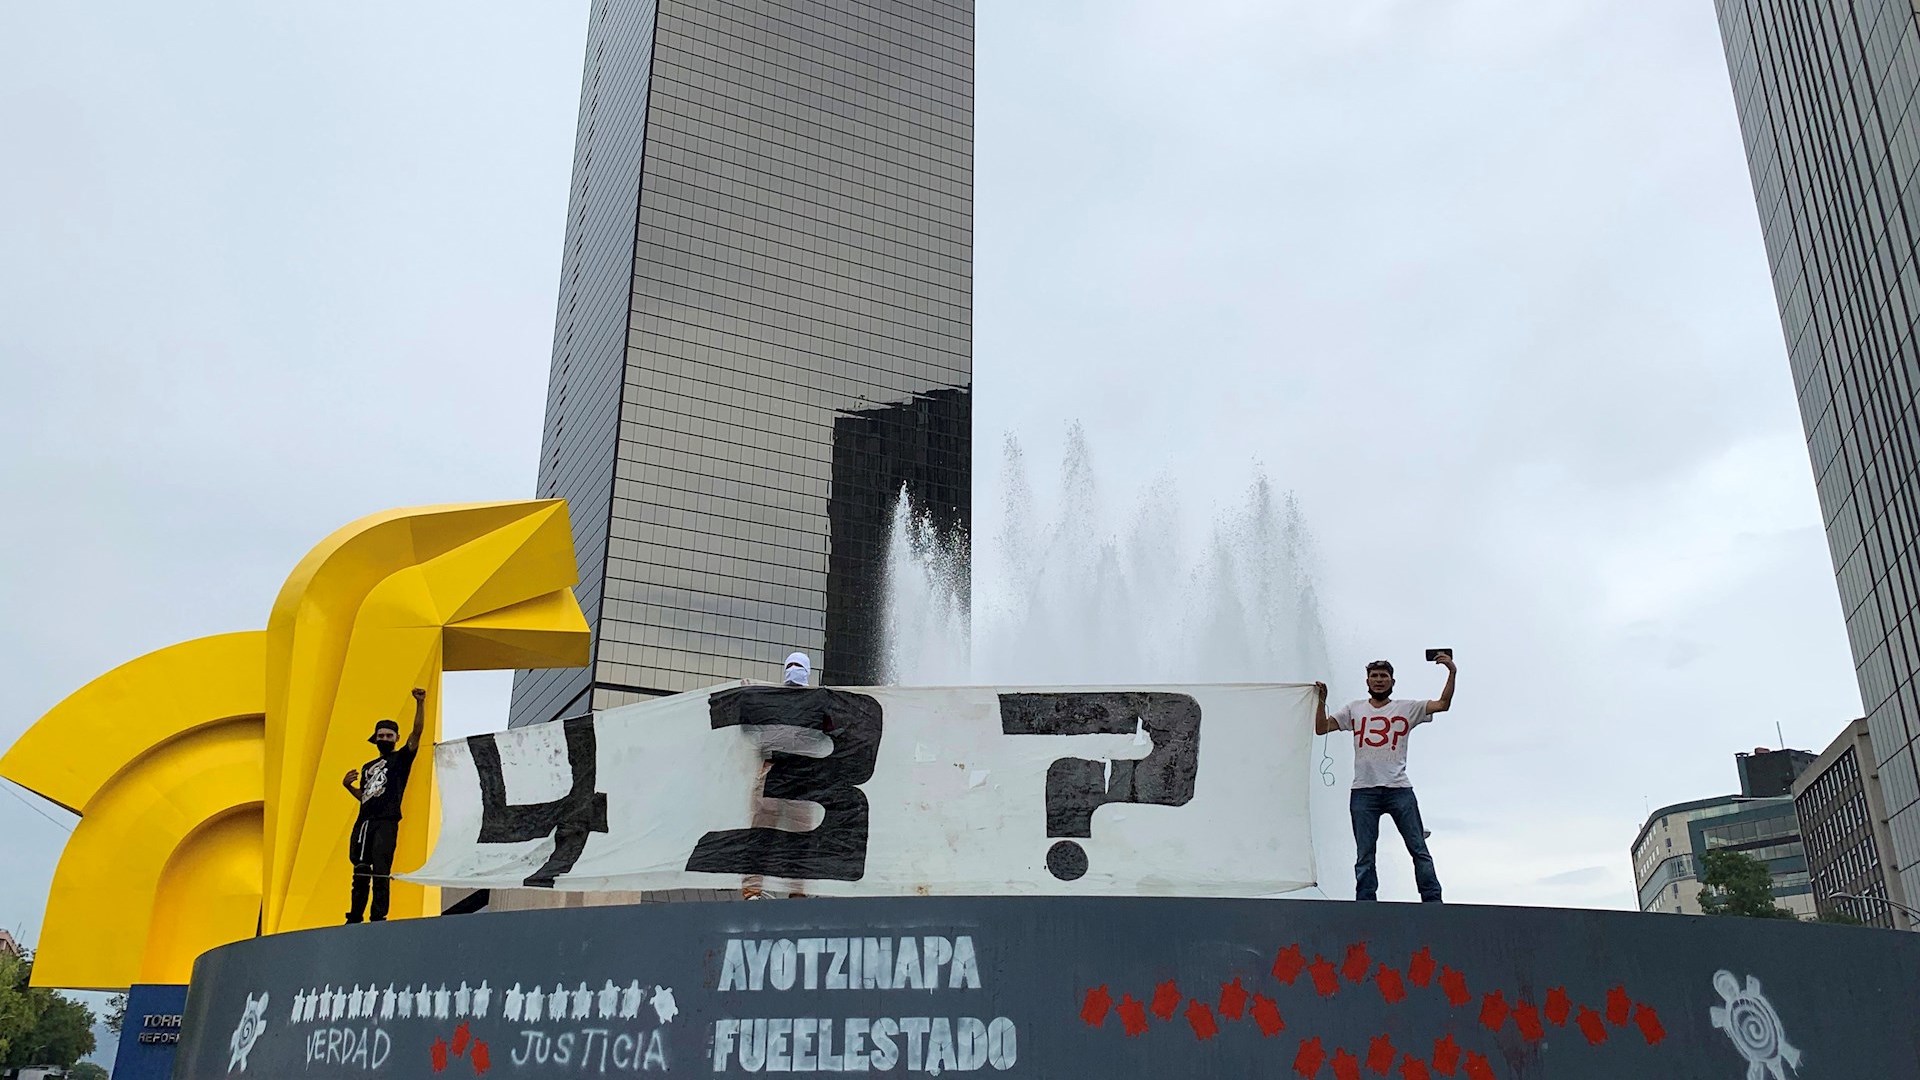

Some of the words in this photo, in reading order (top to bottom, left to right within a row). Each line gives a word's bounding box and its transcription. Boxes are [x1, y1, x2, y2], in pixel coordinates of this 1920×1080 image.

[1351, 715, 1409, 751] 43?
[467, 686, 1202, 887] 43?
[717, 935, 982, 992] AYOTZINAPA
[305, 1027, 391, 1070] VERDAD
[511, 1028, 671, 1072] JUSTICIA
